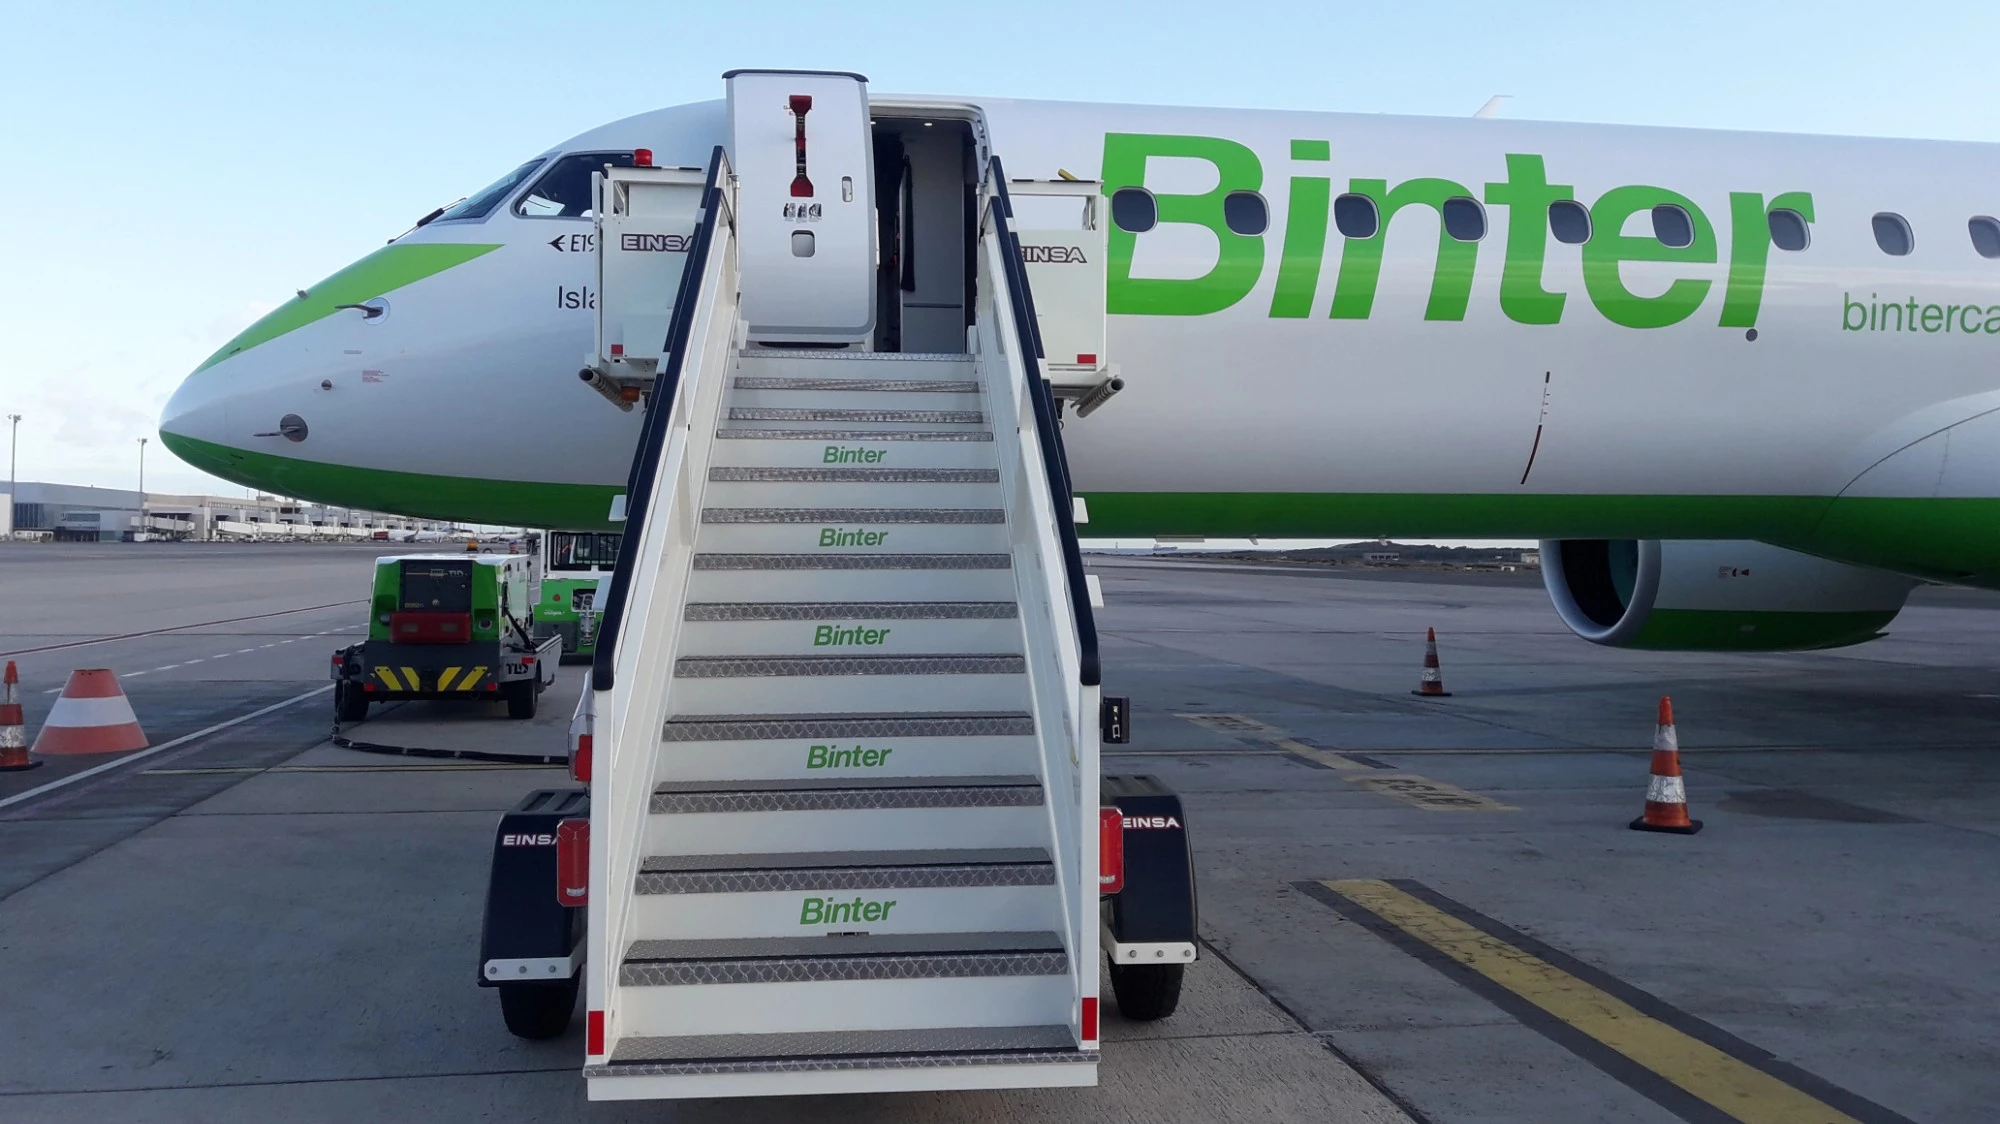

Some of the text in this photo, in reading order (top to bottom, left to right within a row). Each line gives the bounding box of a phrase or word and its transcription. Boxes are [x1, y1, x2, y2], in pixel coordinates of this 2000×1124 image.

[1101, 132, 1816, 329] Binter
[1842, 291, 2000, 334] binterca
[823, 445, 887, 464] Binter
[819, 528, 889, 547] Binter
[814, 625, 891, 646] Binter
[806, 744, 893, 769] Binter
[1123, 817, 1181, 829] EINSA
[800, 896, 897, 925] Binter
